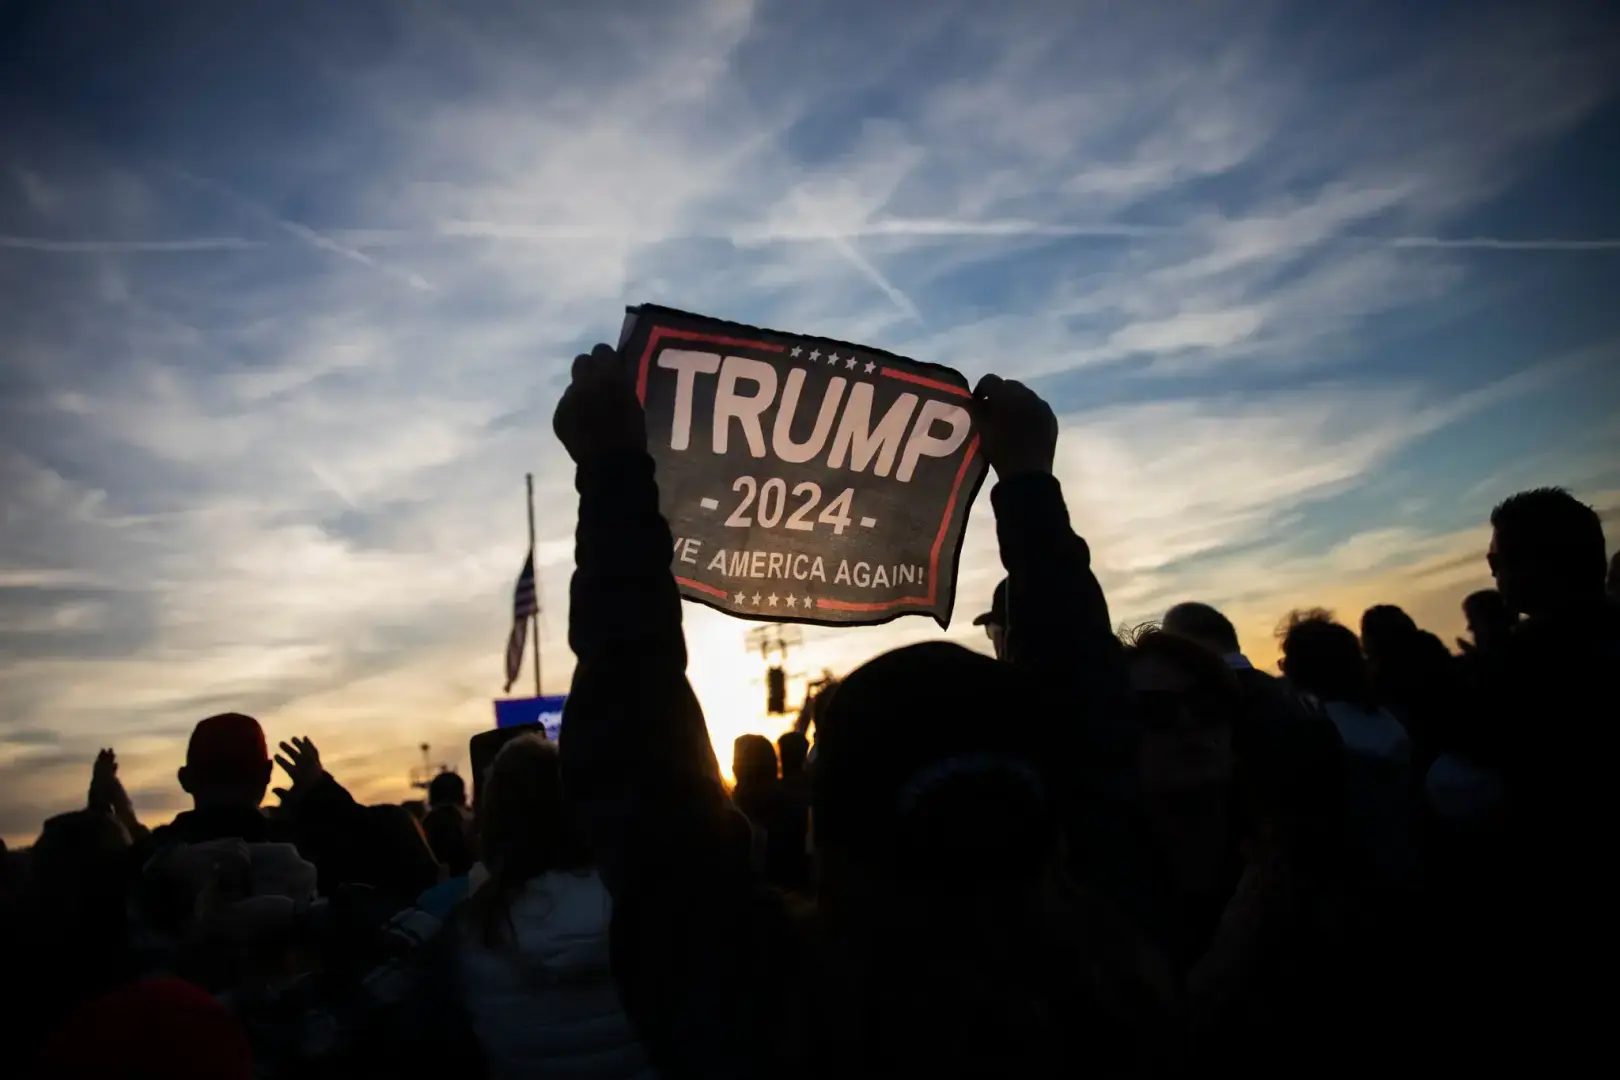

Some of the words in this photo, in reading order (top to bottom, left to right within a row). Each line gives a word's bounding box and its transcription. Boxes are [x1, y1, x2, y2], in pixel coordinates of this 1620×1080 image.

[657, 348, 971, 482] TRUMP
[707, 549, 826, 583] AMERICA
[833, 559, 924, 589] AGAIN!
